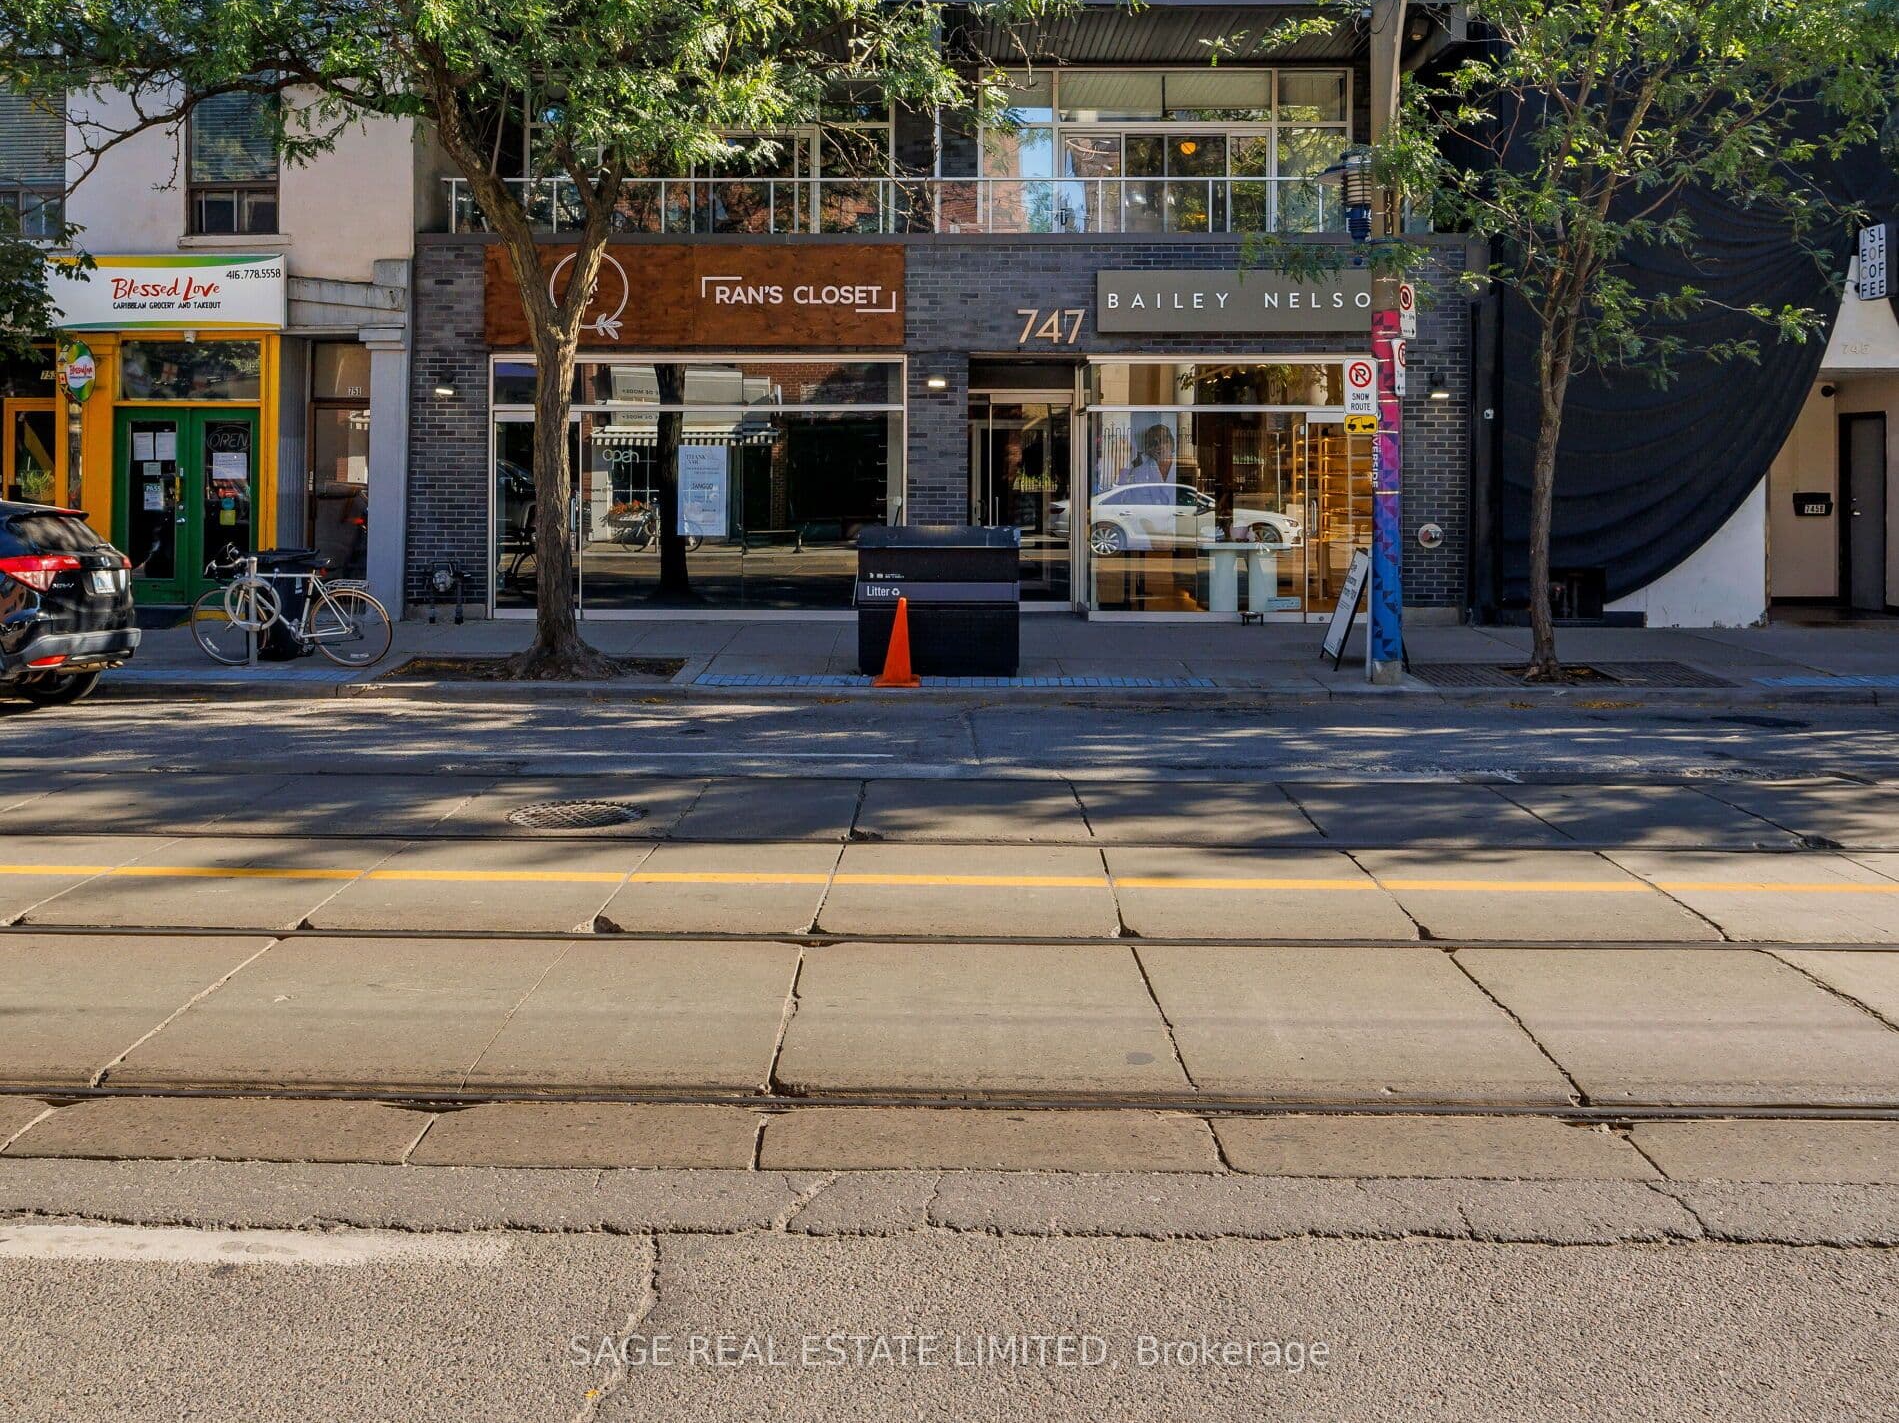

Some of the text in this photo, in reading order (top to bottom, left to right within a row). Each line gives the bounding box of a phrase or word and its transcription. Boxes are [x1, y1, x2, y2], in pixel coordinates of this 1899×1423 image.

[226, 268, 281, 280] 416.778.5558
[111, 276, 221, 301] Blessed Love
[715, 285, 882, 305] RAN'S CLOSET
[1861, 279, 1885, 298] FEE
[112, 301, 221, 310] CARIBBEAN GROCERY AND TAKEOUT
[1107, 292, 1371, 309] BAILEY NELSO
[1017, 308, 1085, 344] 747
[1352, 392, 1370, 401] SNOW
[1350, 403, 1371, 411] ROUTE
[209, 433, 248, 448] OPEN
[602, 449, 640, 470] open
[866, 585, 890, 597] Litter
